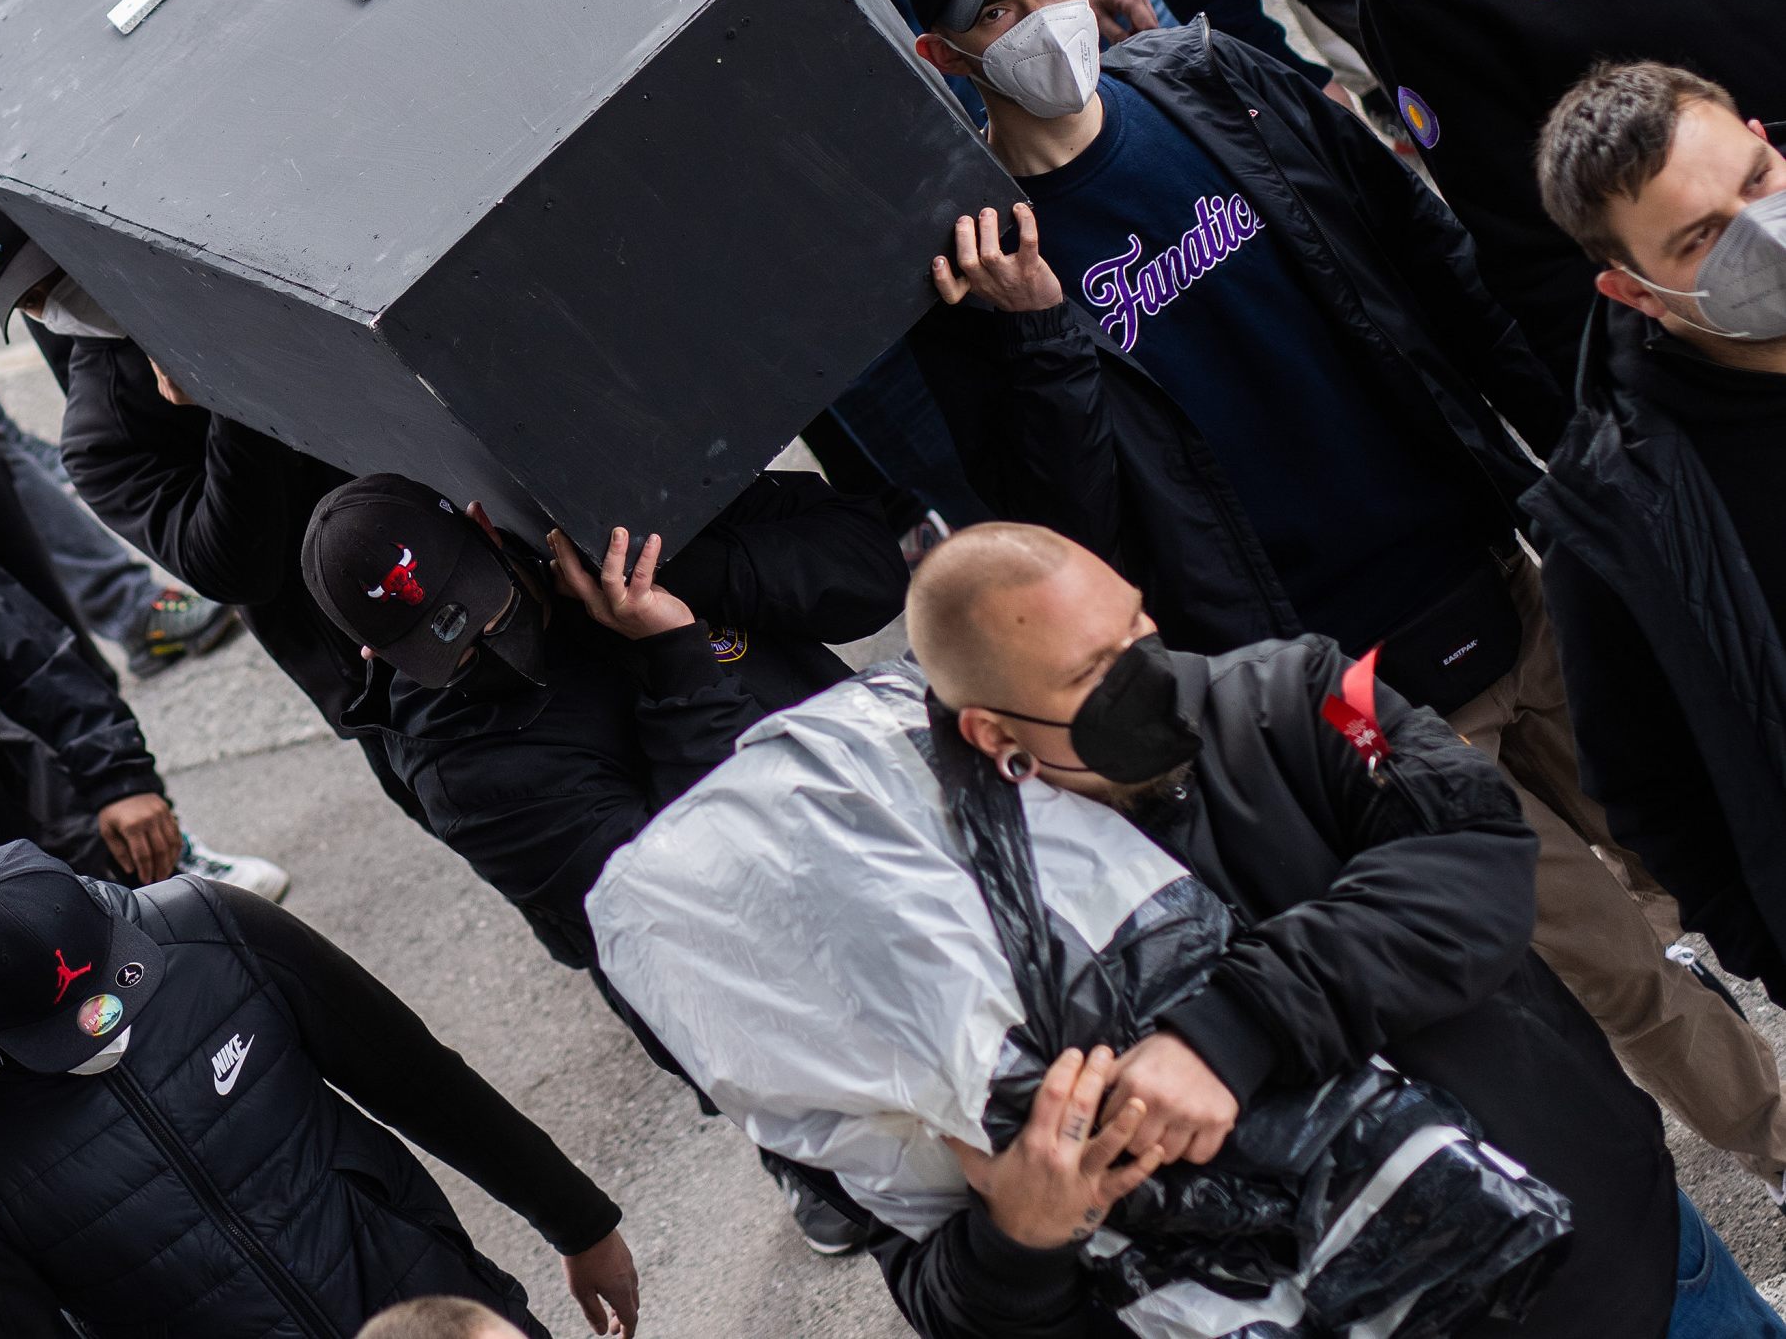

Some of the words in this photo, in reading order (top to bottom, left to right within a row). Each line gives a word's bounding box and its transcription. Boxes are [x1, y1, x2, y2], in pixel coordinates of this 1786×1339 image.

[1082, 193, 1266, 353] Fanatic
[1443, 639, 1478, 666] EASTPAK
[211, 1033, 247, 1079] NIKE
